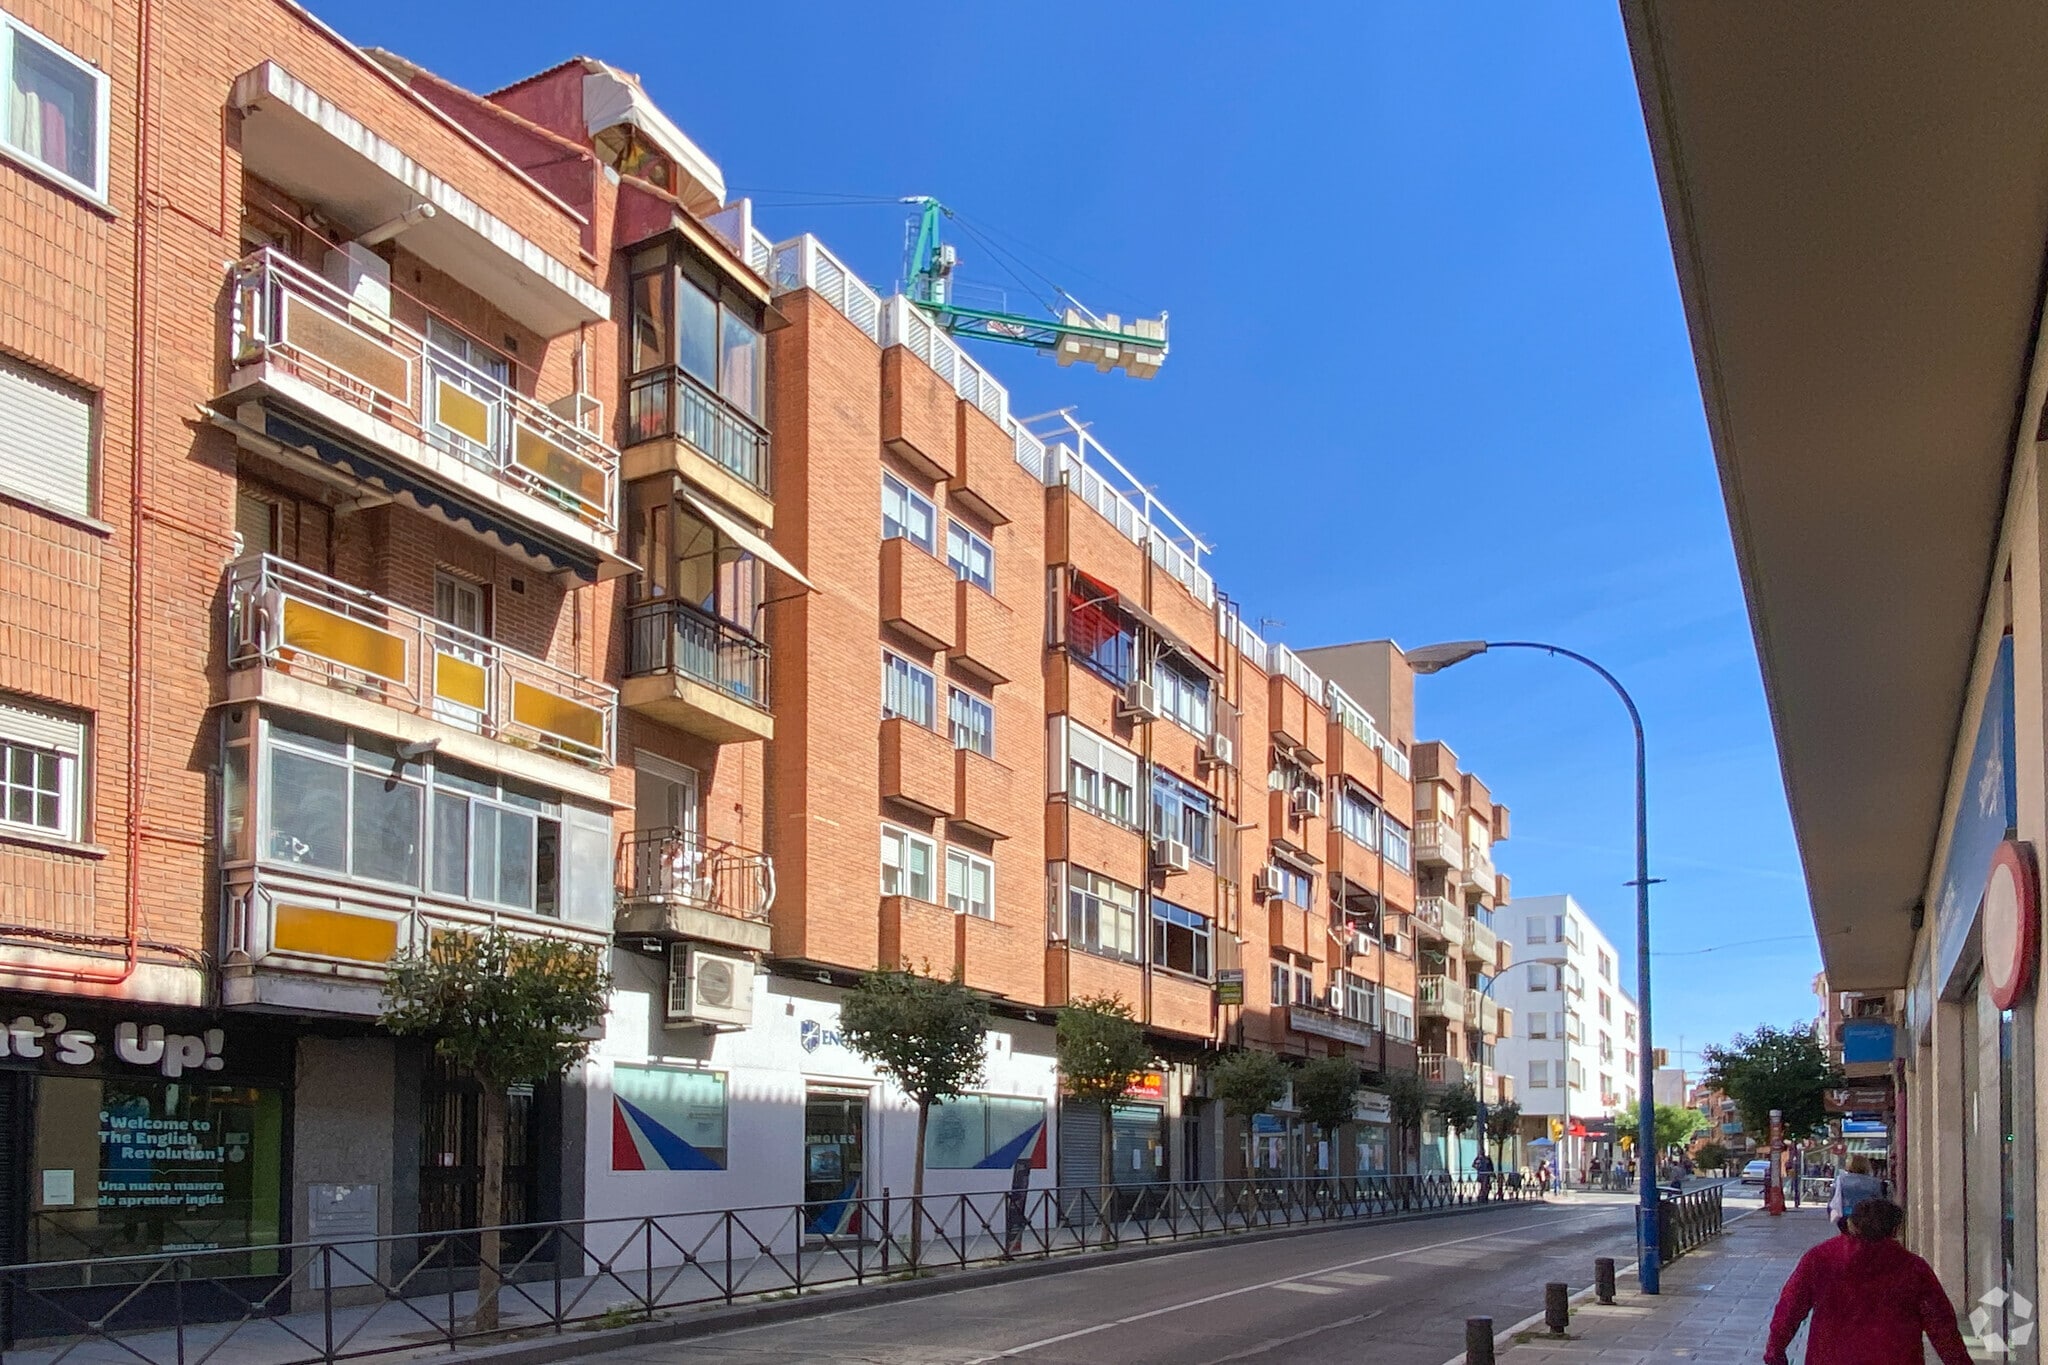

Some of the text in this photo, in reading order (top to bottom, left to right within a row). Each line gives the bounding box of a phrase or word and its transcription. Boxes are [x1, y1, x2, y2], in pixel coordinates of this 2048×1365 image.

[0, 1012, 225, 1078] t’s Up!
[192, 1119, 211, 1132] to
[97, 1130, 198, 1147] The English
[121, 1146, 225, 1162] Revolution!
[98, 1181, 224, 1191] Una nueva manera
[98, 1193, 224, 1207] de aprender inglés
